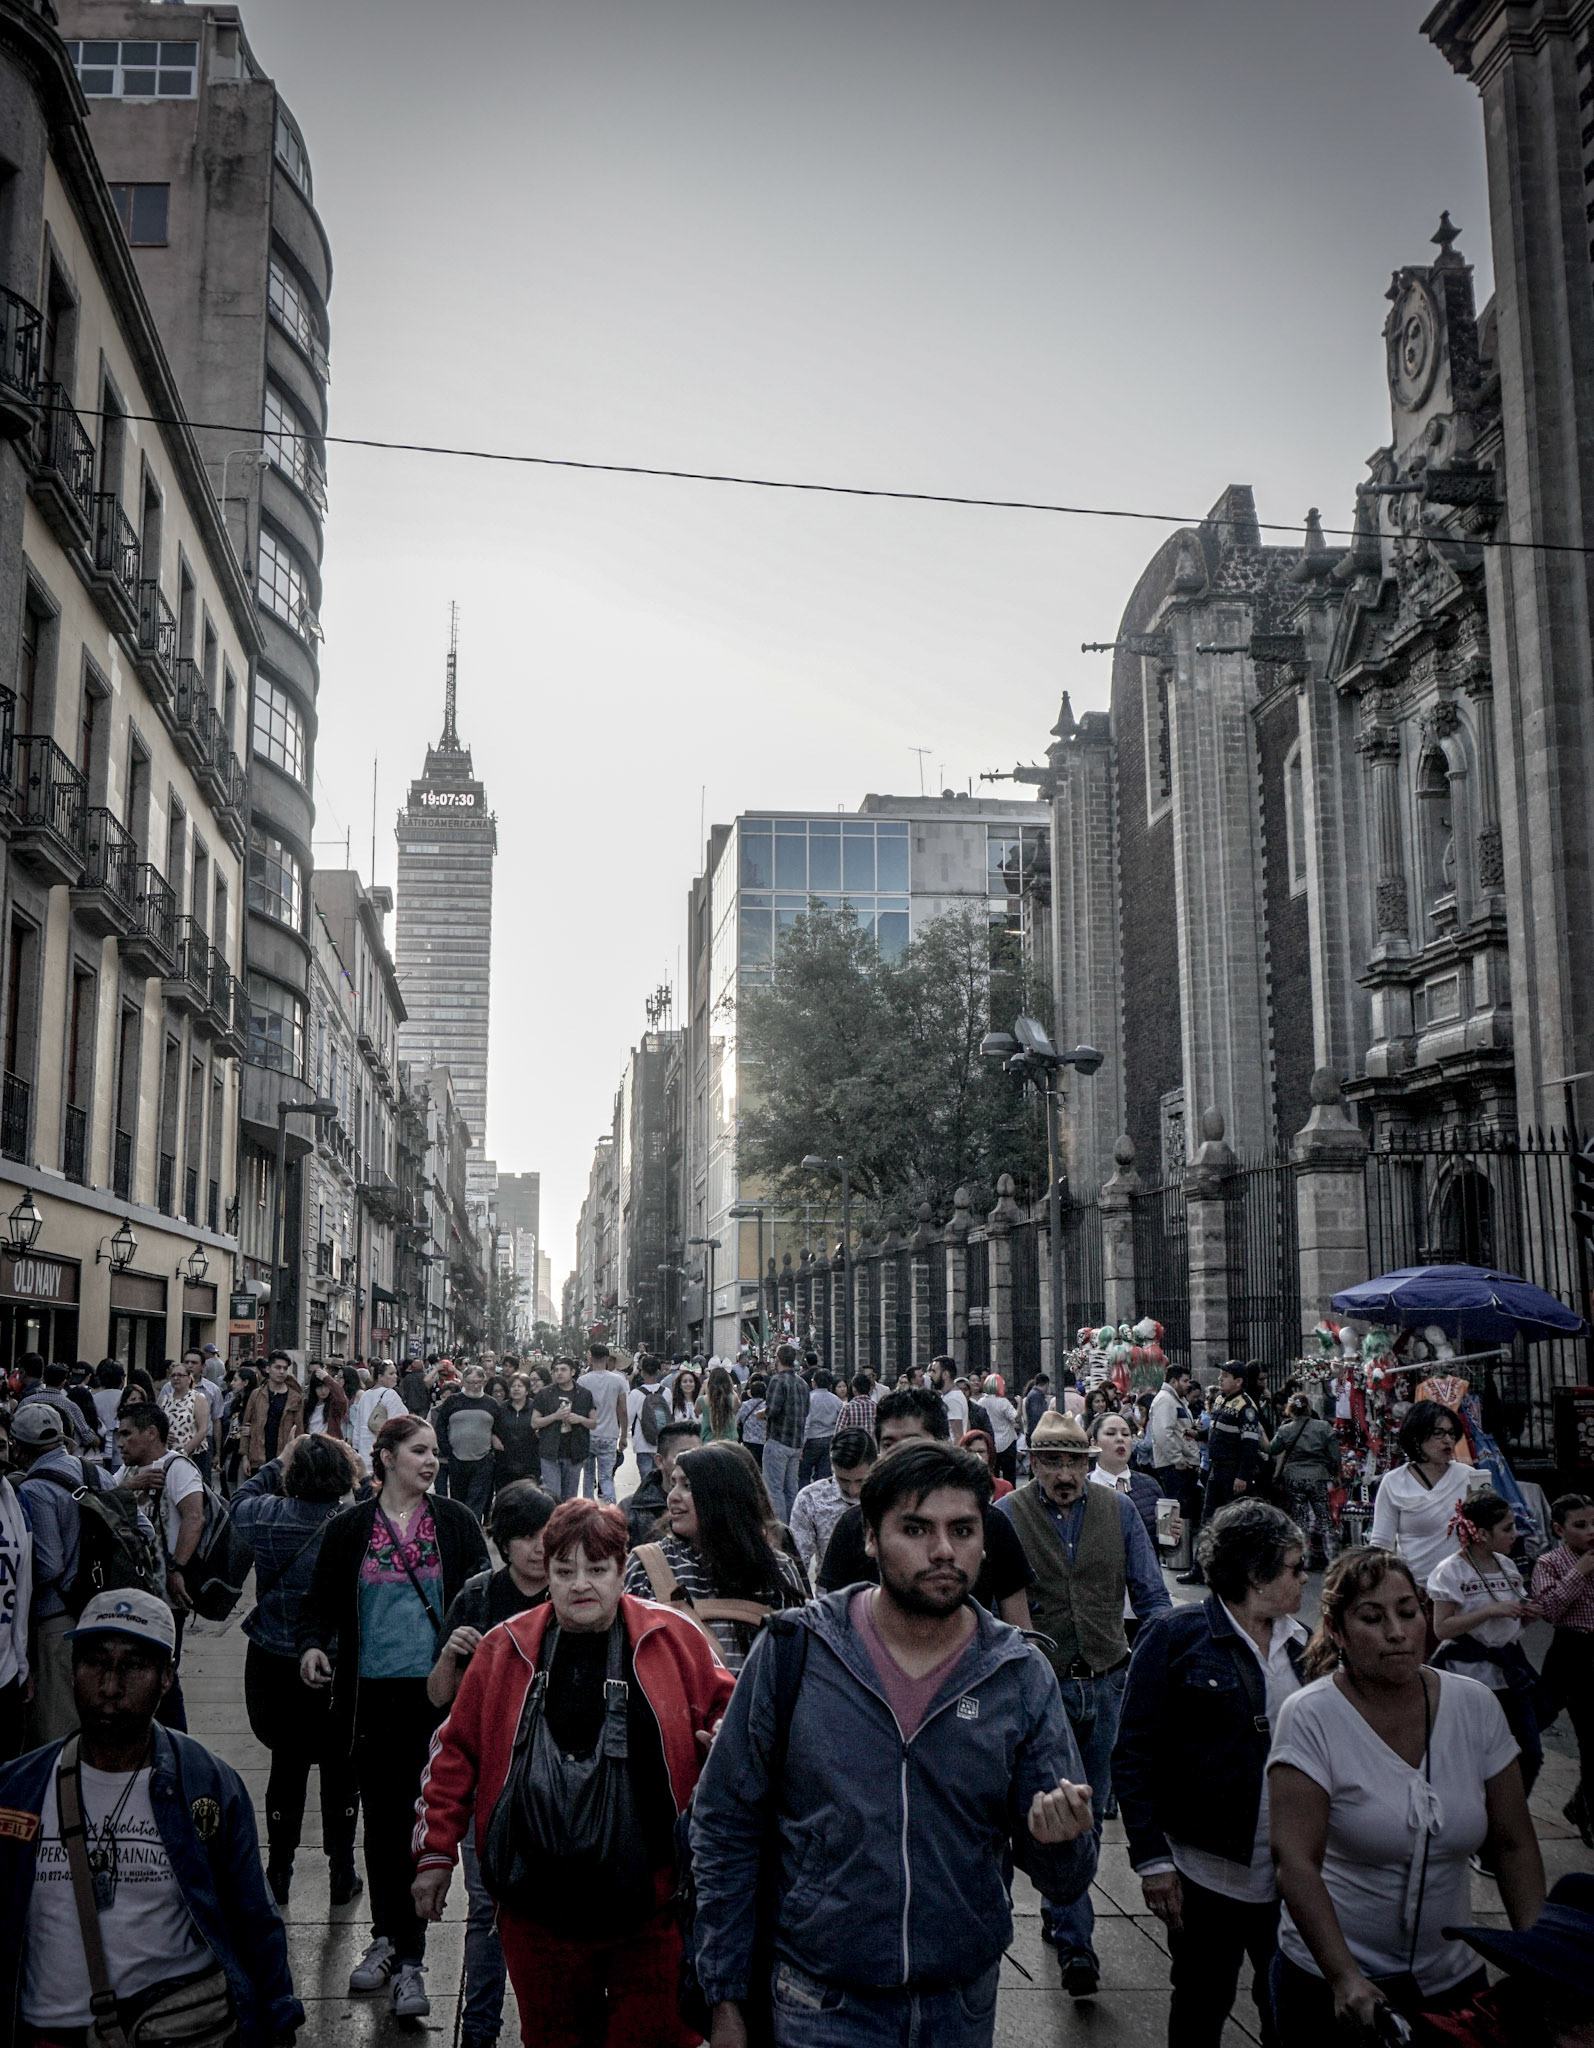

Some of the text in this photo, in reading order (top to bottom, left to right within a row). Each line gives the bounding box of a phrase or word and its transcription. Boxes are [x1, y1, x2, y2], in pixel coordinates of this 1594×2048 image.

[420, 793, 475, 806] 19:07:30
[402, 819, 489, 828] LATINOAMERICANA
[14, 1259, 62, 1297] OLD NAVY
